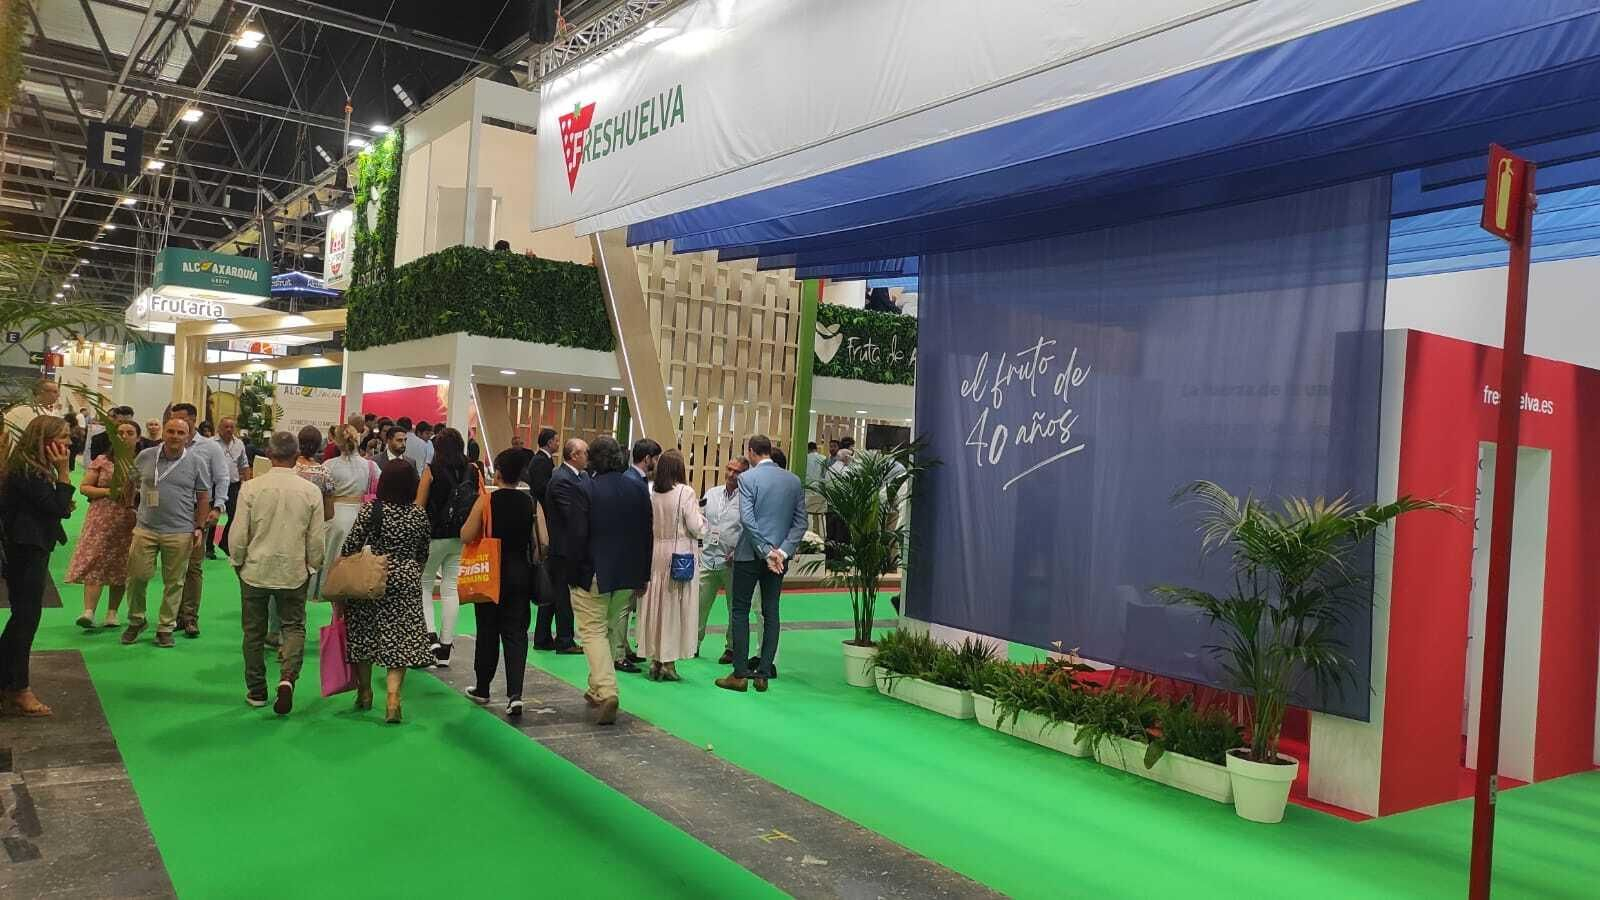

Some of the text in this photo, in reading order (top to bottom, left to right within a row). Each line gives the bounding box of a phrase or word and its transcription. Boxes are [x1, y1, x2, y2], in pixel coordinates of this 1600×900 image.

[102, 131, 127, 166] E
[572, 84, 685, 168] FRESHUELVA
[9, 333, 17, 342] E
[846, 336, 881, 365] Fruta
[887, 334, 905, 366] de
[960, 335, 1091, 409] el fruto de
[965, 407, 1080, 466] 40 años
